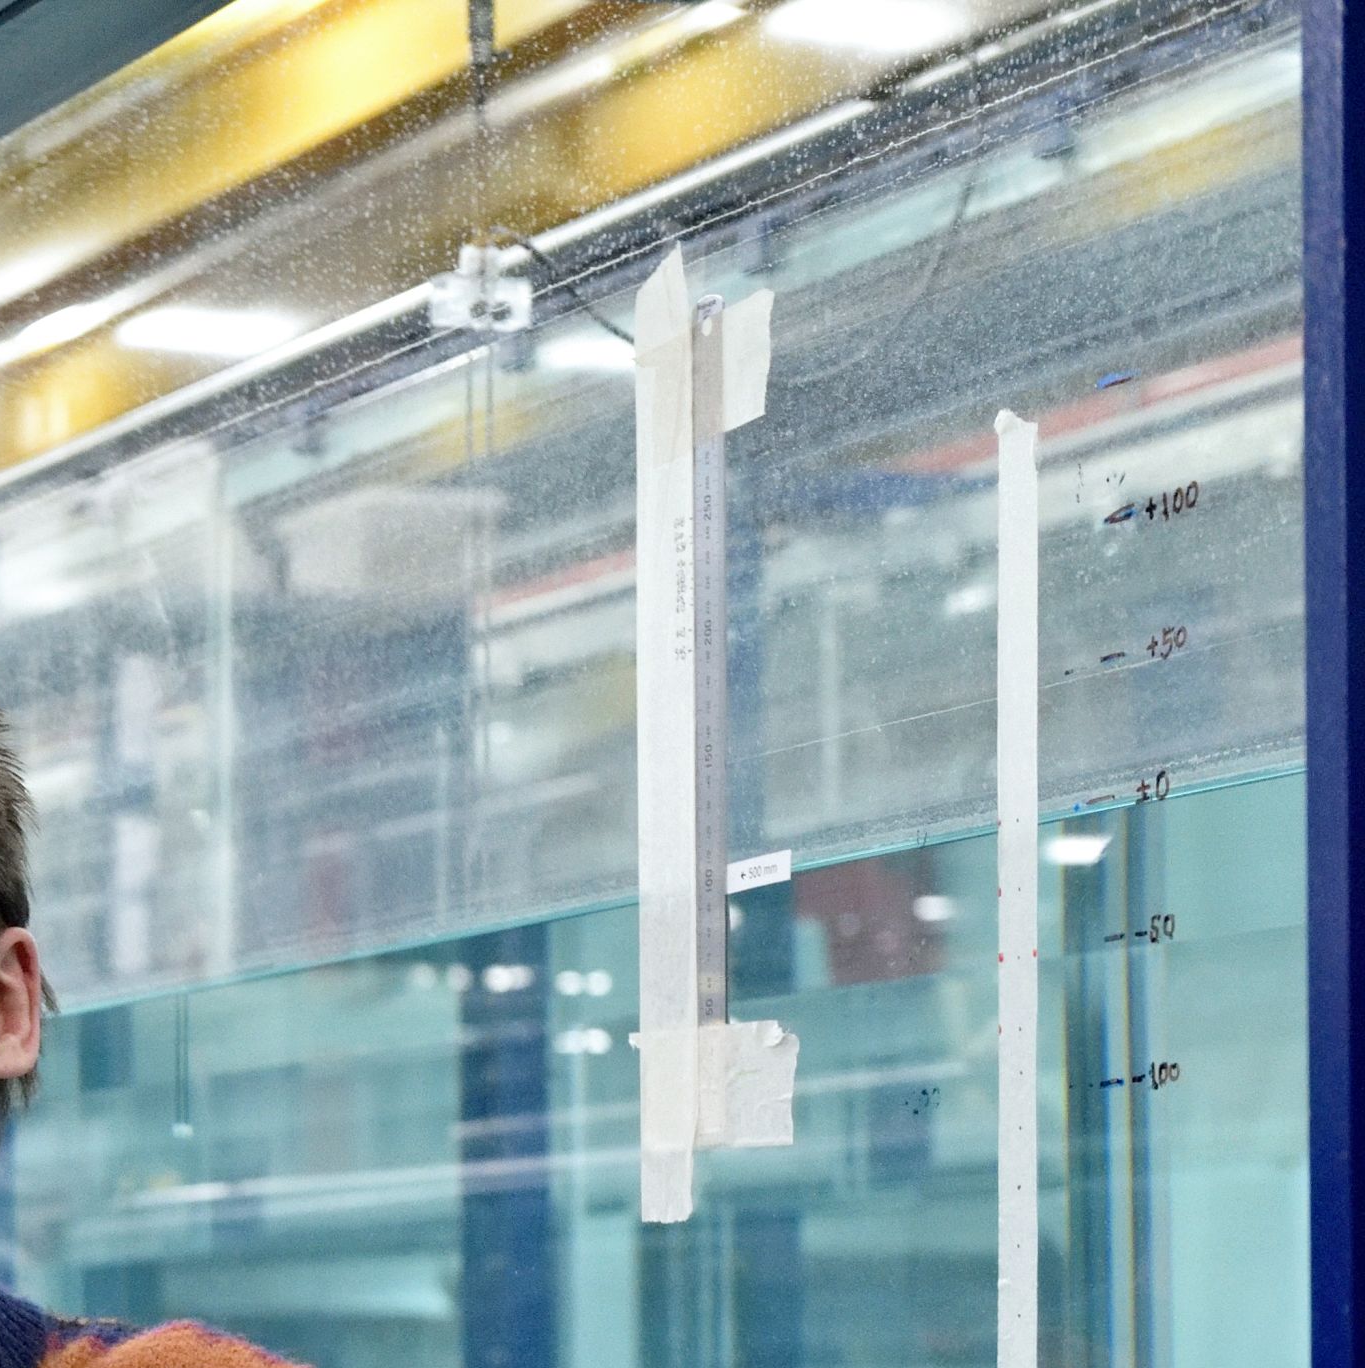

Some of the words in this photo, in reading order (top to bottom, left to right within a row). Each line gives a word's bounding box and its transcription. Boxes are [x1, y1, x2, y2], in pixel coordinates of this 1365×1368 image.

[703, 494, 711, 521] 250
[1145, 481, 1199, 521] +100
[704, 619, 712, 646] 200
[1147, 625, 1187, 660] +50
[704, 743, 712, 768] 150
[705, 869, 713, 893] 100
[749, 865, 763, 879] 500
[764, 864, 778, 875] mm
[705, 998, 713, 1016] 50
